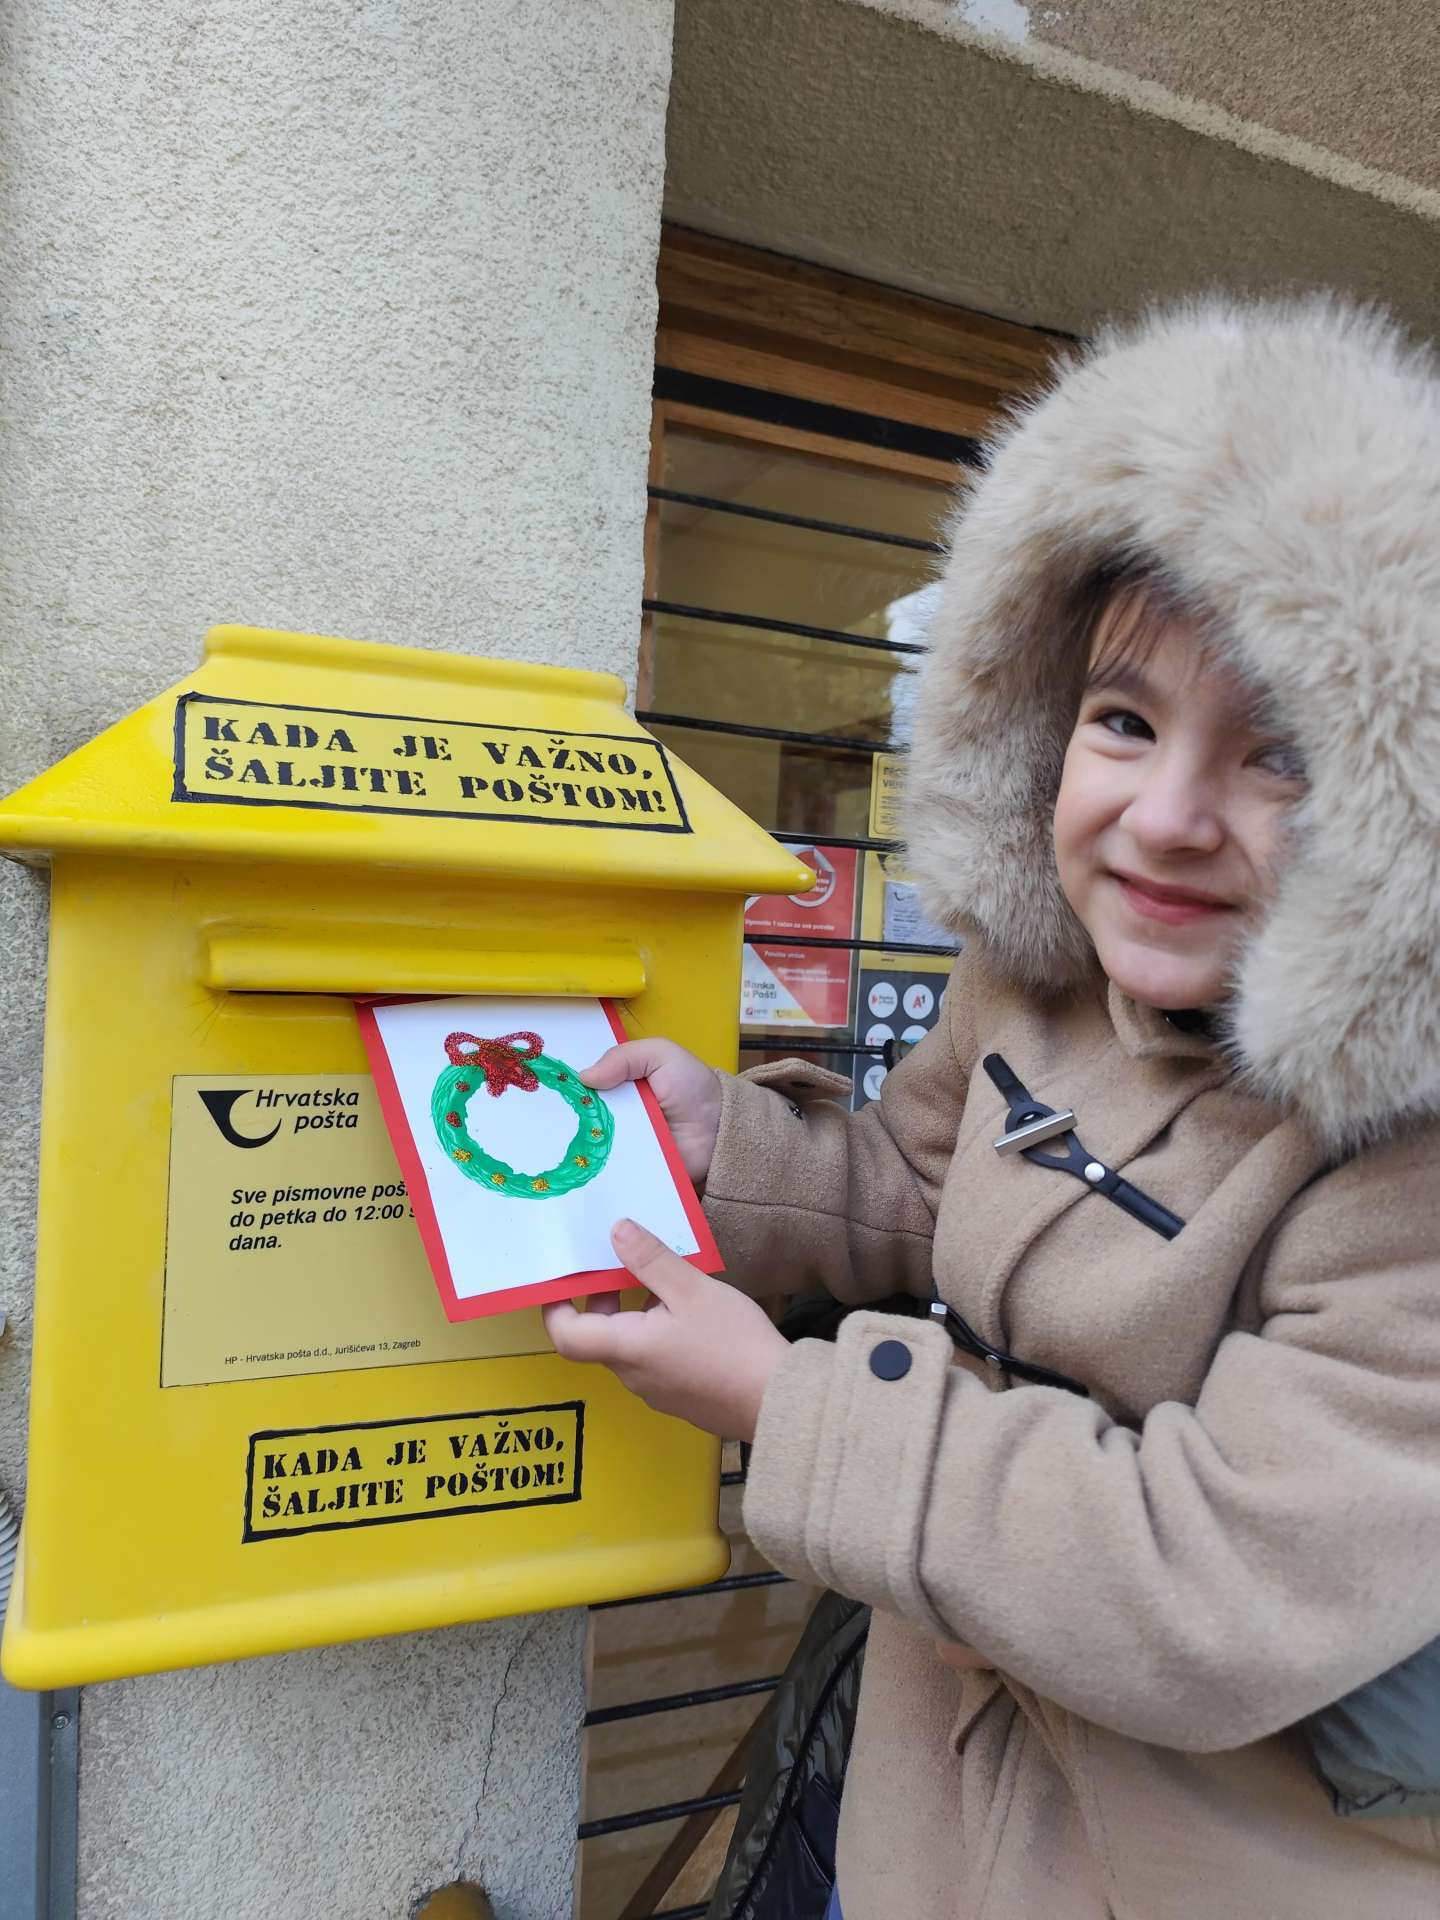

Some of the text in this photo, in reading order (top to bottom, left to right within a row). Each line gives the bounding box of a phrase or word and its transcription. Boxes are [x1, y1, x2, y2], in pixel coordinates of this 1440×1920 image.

[201, 716, 653, 780] KADA JE VAŽNO,
[204, 747, 667, 813] ŠALJITE POŠTOM!
[744, 980, 775, 989] Banka
[752, 990, 777, 999] Pošti
[255, 1088, 360, 1108] Hrvatska
[293, 1111, 359, 1134] pošta
[231, 1180, 409, 1206] Sve pismovne poš
[230, 1211, 254, 1228] do
[260, 1207, 318, 1229] petka
[323, 1206, 347, 1223] do
[354, 1203, 404, 1221] 12:00
[229, 1234, 282, 1251] dana.
[225, 1356, 237, 1365] HP
[246, 1352, 285, 1363] Hrvatska
[287, 1349, 312, 1361] pošta
[313, 1347, 333, 1358] d.d.,
[334, 1343, 376, 1355] Jurišićeva
[379, 1342, 390, 1352] 13,
[392, 1339, 421, 1351] Zagreb
[262, 1421, 565, 1479] KADA JE VAŽNO,
[262, 1461, 565, 1518] ŠALJITE POŠTOM!
